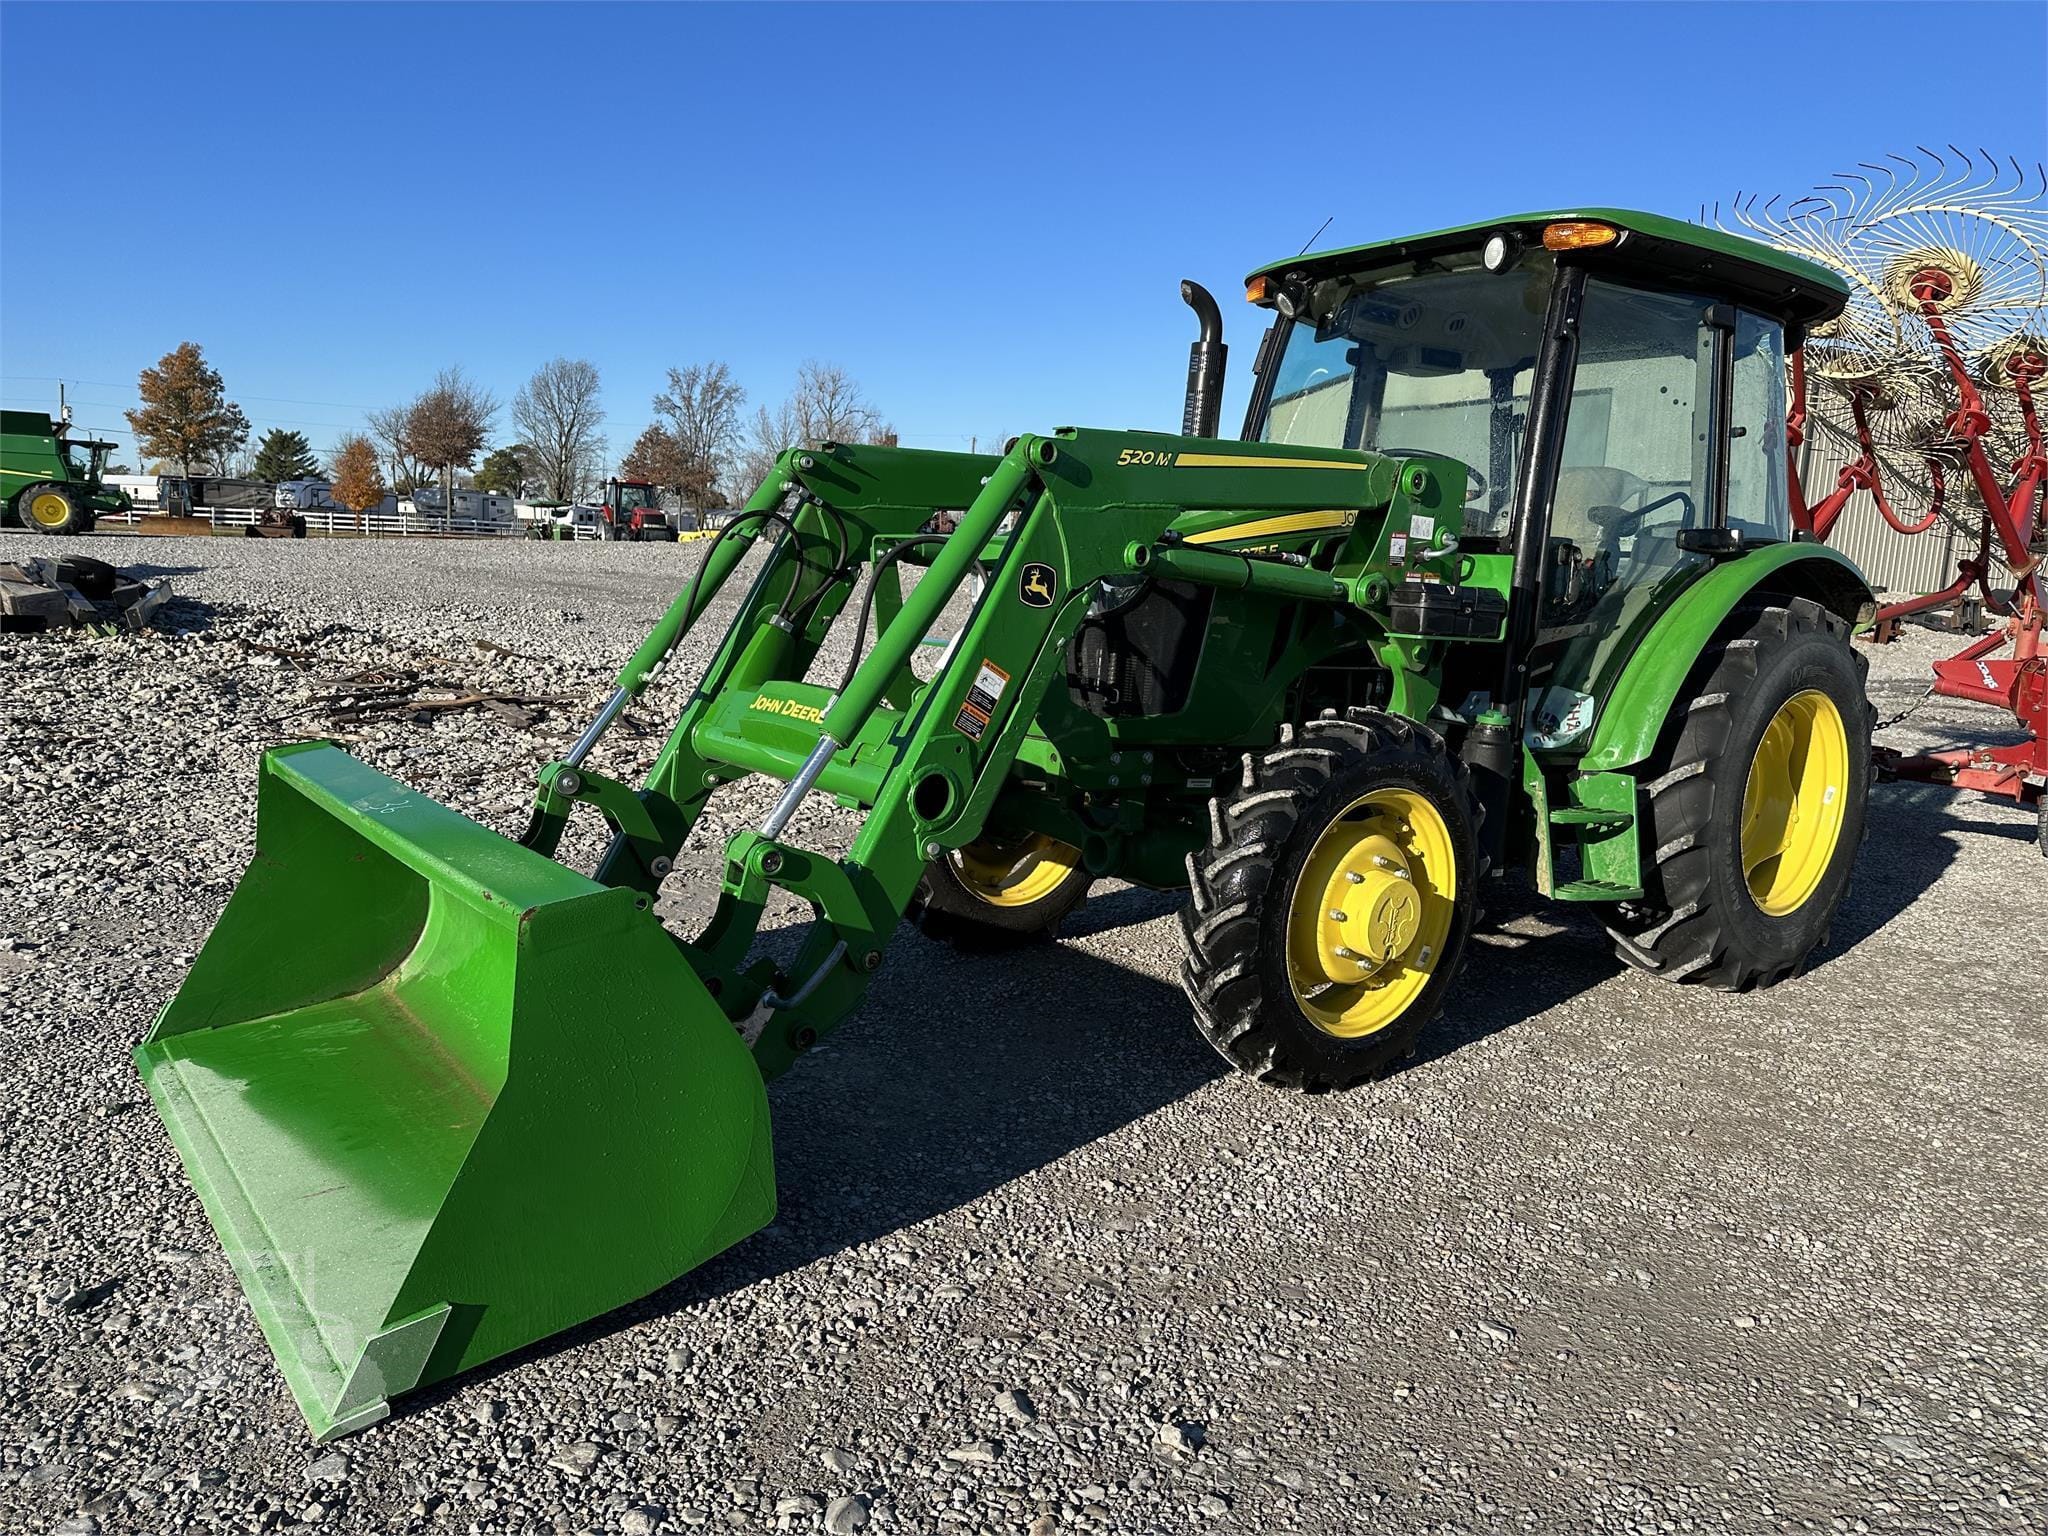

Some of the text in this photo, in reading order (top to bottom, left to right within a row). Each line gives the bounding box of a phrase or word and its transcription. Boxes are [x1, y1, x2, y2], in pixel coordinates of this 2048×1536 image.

[1117, 449, 1173, 466] 520 M
[749, 694, 785, 713] JOHN
